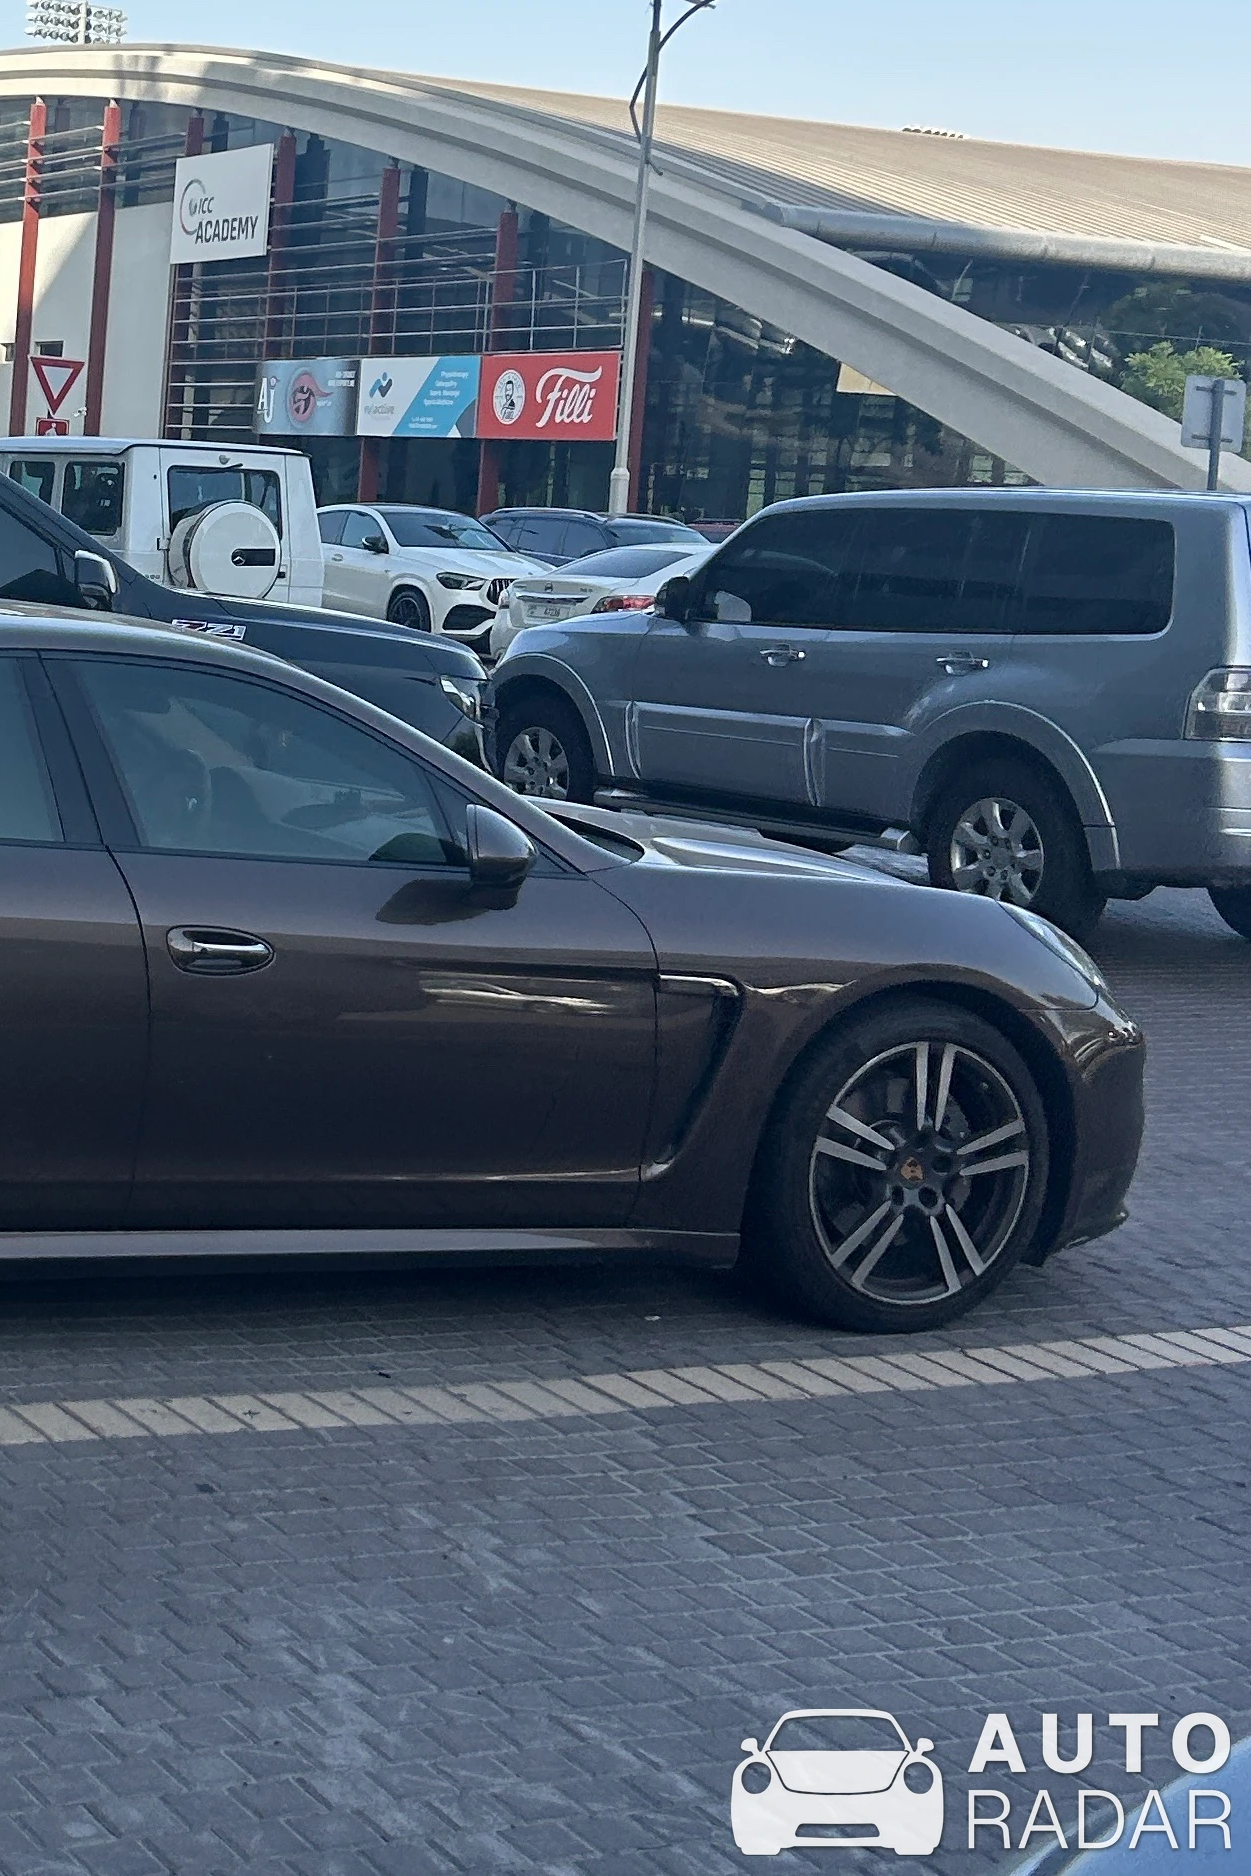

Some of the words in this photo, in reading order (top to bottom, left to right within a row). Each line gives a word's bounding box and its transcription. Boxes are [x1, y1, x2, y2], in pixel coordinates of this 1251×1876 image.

[198, 196, 215, 214] ICC
[195, 215, 259, 244] ACADEMY
[535, 365, 603, 428] Filli
